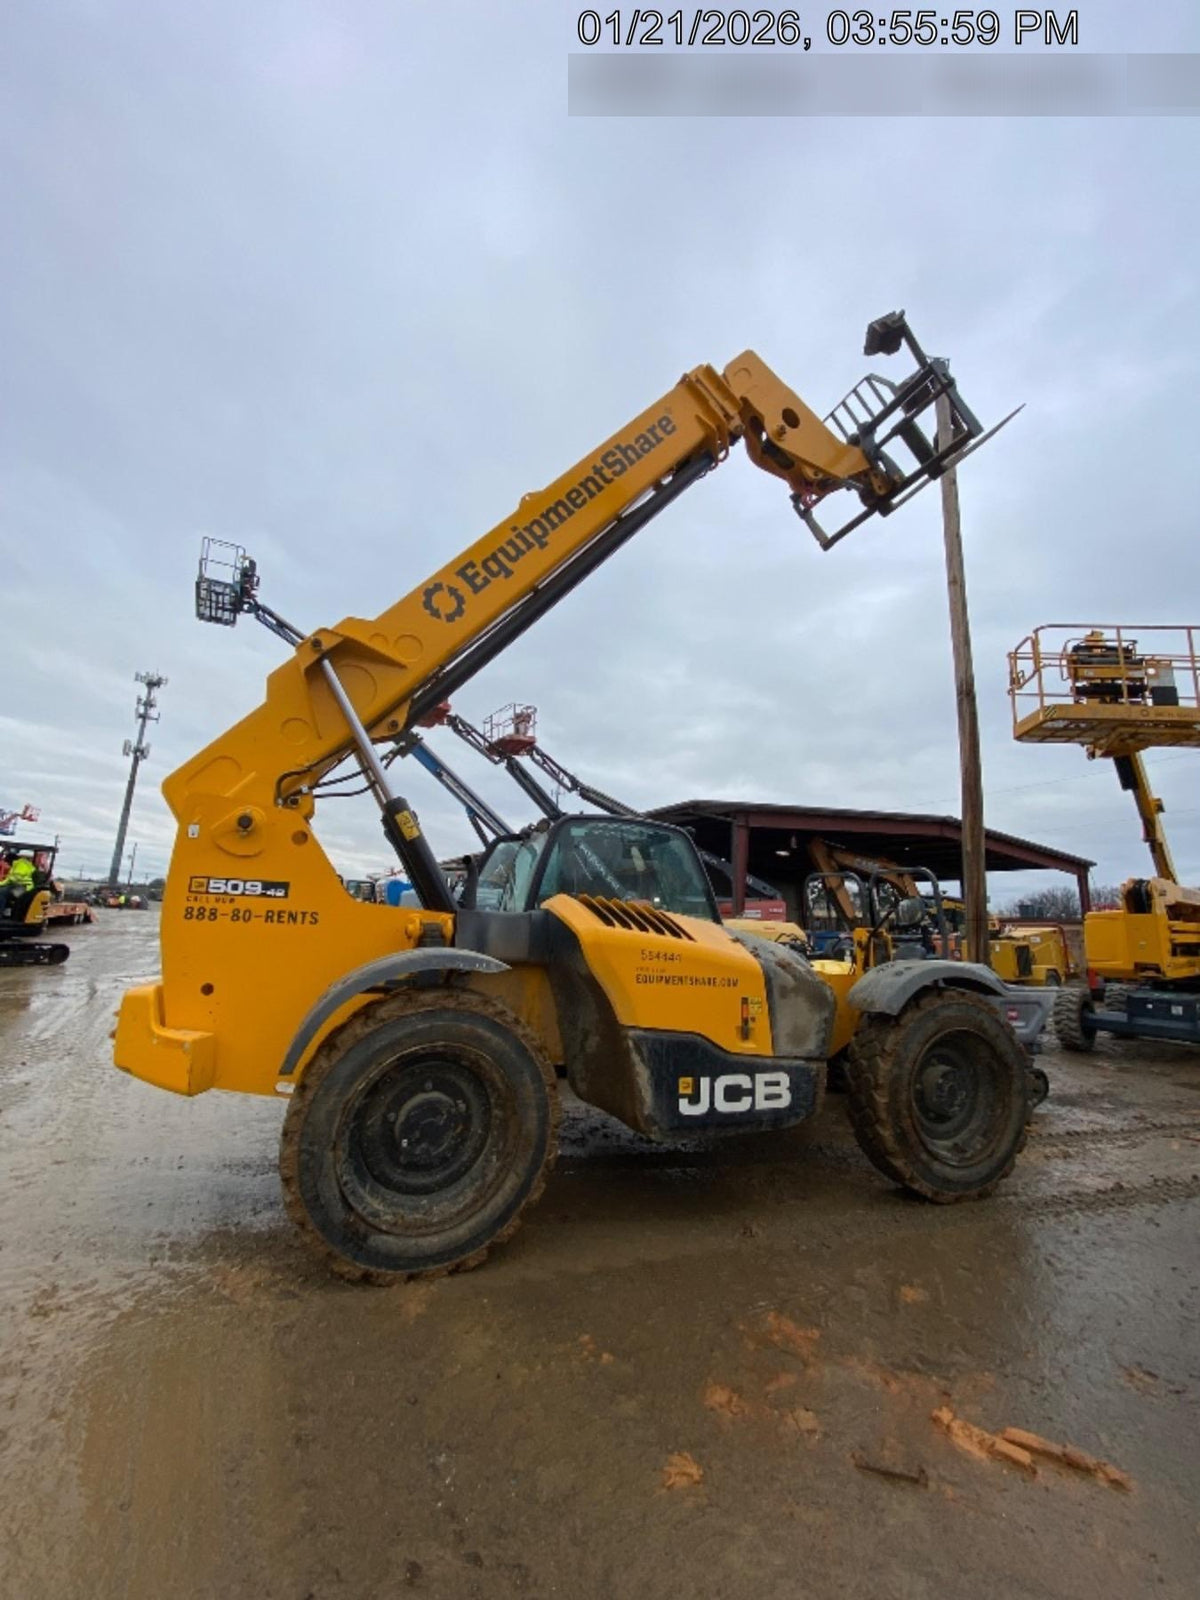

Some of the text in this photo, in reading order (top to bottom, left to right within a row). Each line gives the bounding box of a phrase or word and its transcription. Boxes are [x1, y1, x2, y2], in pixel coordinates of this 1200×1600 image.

[455, 414, 678, 595] EquipmentShare
[184, 906, 319, 925] 888-80-RENTS
[678, 1072, 792, 1116] JCB
